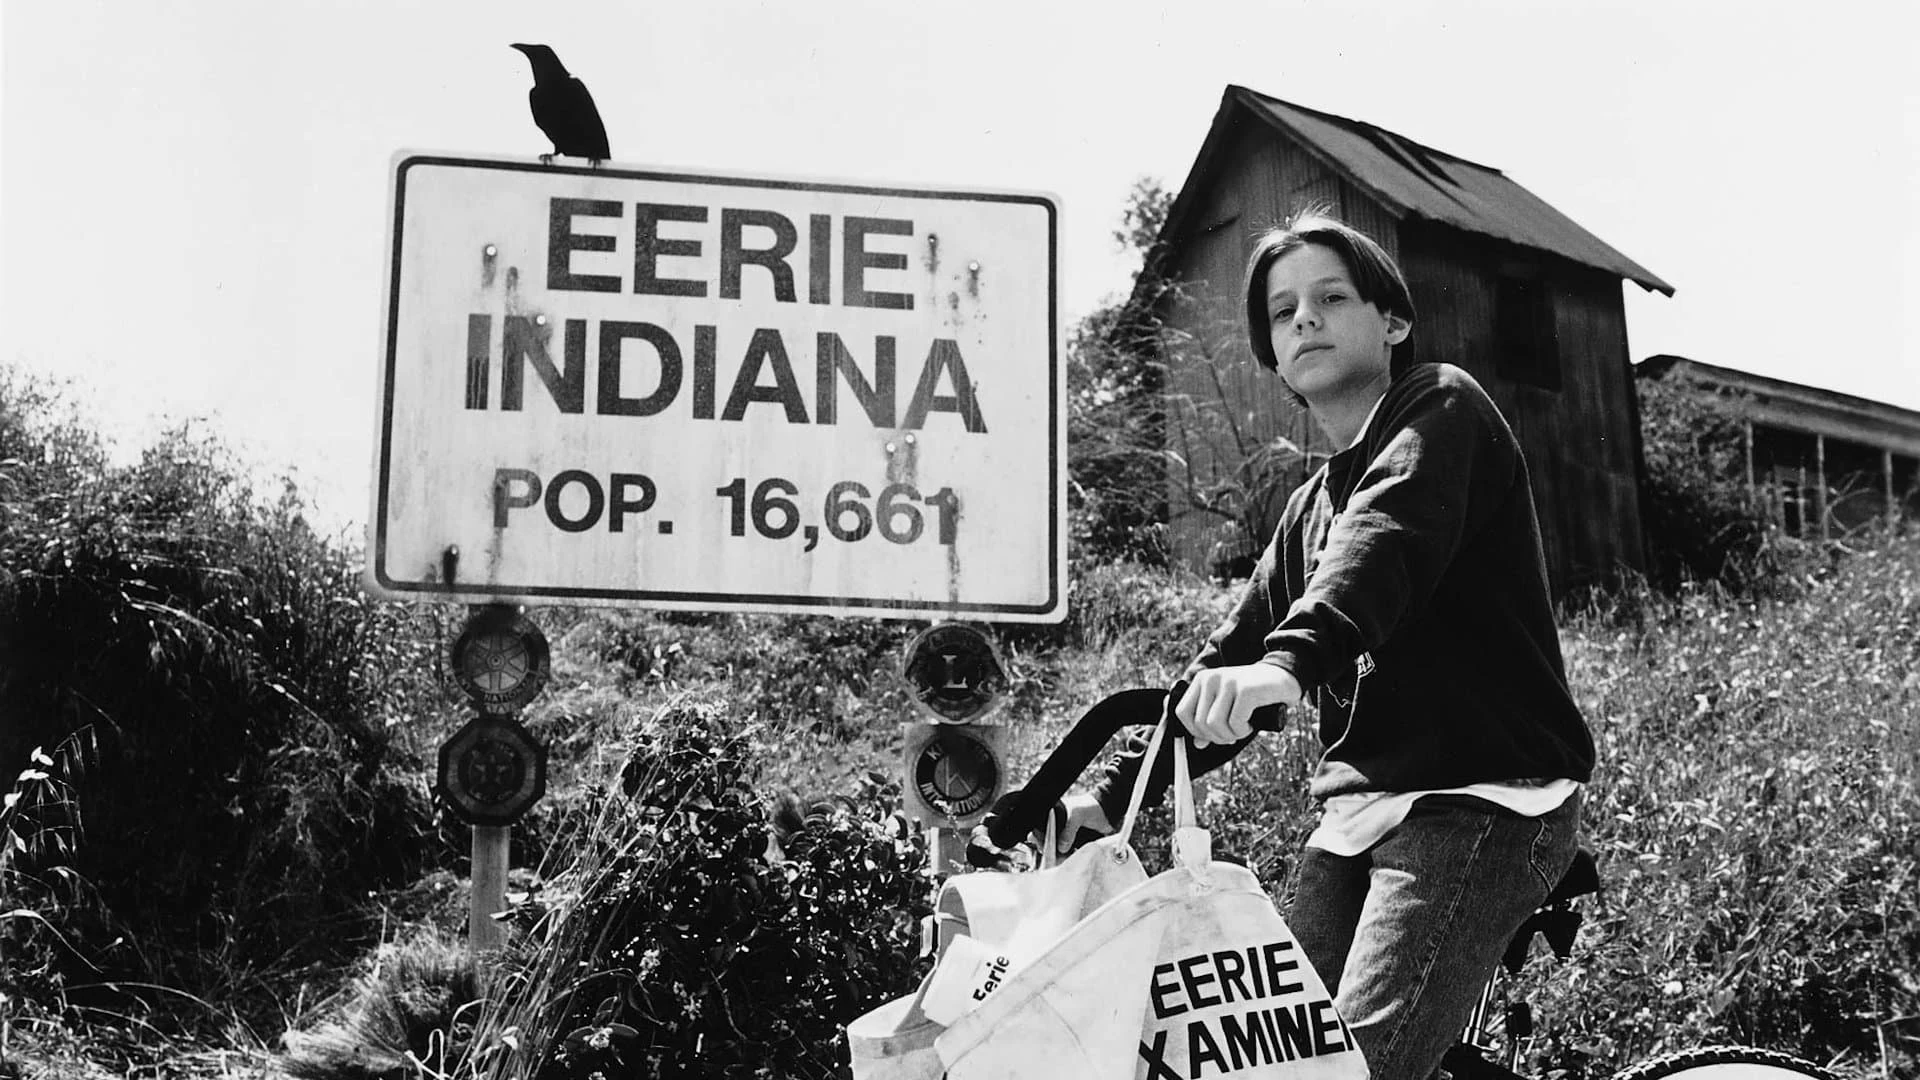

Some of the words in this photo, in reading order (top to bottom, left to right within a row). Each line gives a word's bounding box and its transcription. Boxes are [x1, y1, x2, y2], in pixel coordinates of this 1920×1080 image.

[546, 196, 915, 311] EERIE
[465, 313, 988, 433] INDIANA
[493, 467, 673, 535] POP.
[716, 477, 956, 552] 16,661
[973, 956, 1010, 1001] Eerie
[1150, 941, 1304, 1019] EERIE
